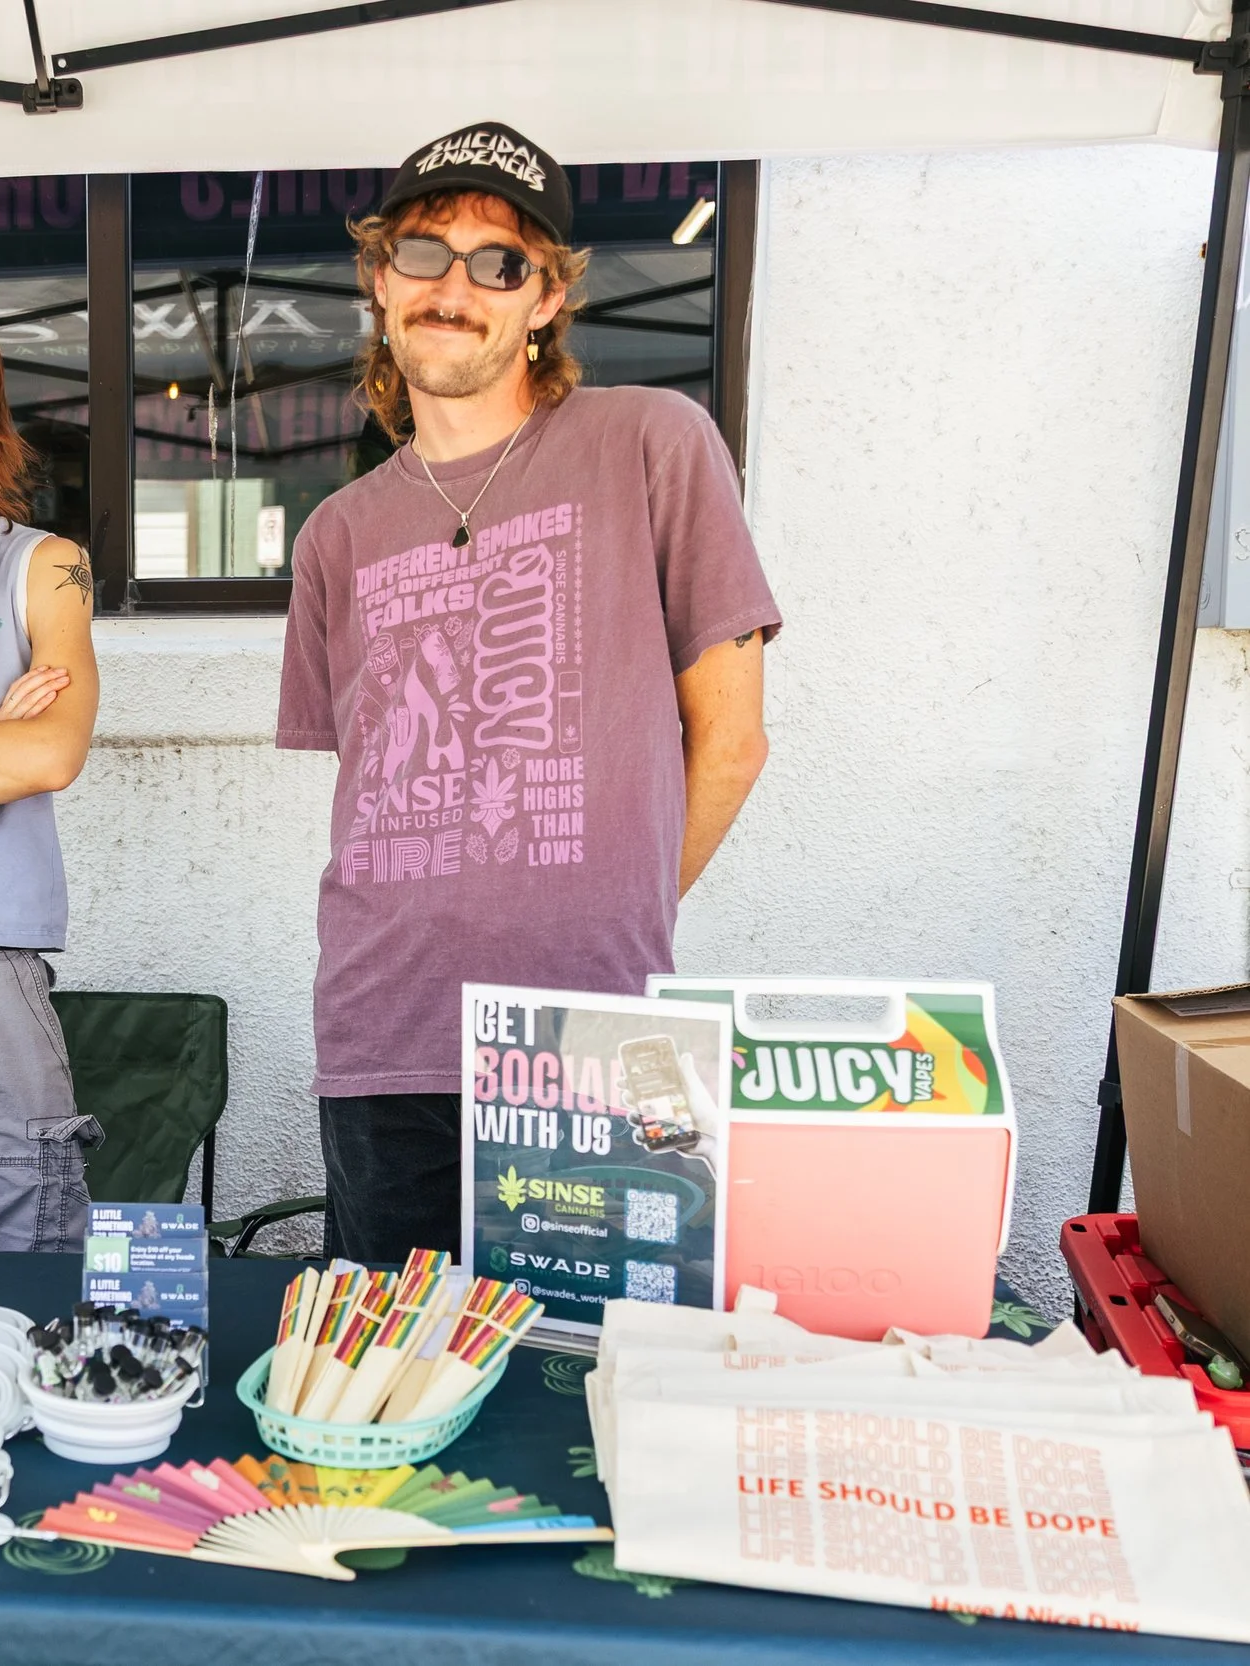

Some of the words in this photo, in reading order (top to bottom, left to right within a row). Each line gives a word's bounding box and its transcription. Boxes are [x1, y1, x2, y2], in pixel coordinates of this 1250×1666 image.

[432, 130, 547, 177] SUICIDAL
[416, 150, 547, 192] TENDENCIES
[356, 540, 470, 598] DIFFERENT
[476, 503, 572, 561] SMOKES
[400, 552, 506, 596] DIFFERENT
[555, 550, 566, 589] SINSE
[366, 582, 475, 639] FOLKS
[555, 592, 566, 665] CANNABIS
[525, 756, 584, 783] MORE
[523, 784, 584, 811] HIGHS
[381, 808, 463, 832] INFUSED
[532, 812, 584, 838] THAN
[340, 828, 463, 886] FIRE
[528, 840, 584, 867] LOWS
[476, 1000, 542, 1046] GET
[475, 1046, 628, 1118] SOCIAL
[740, 1047, 913, 1104] JUICY
[914, 1051, 934, 1101] VAPES
[475, 1105, 557, 1150] WITH
[572, 1114, 612, 1156] US
[528, 1178, 605, 1207] SINSE
[92, 1210, 99, 1220] A
[100, 1209, 122, 1220] LITTLE
[555, 1203, 606, 1219] CANNABIS
[161, 1222, 199, 1230] SWADE
[541, 1219, 608, 1238] @sinseofficial
[93, 1252, 123, 1273] $10
[510, 1252, 610, 1279] SWADE
[90, 1279, 97, 1290] A
[98, 1279, 120, 1290] LITTLE
[160, 1293, 200, 1301] SWADE
[738, 1475, 806, 1499] LIFE
[818, 1480, 956, 1521] SHOULD
[969, 1505, 1013, 1529] BE
[1025, 1510, 1119, 1540] DOPE
[1004, 1603, 1018, 1620] A
